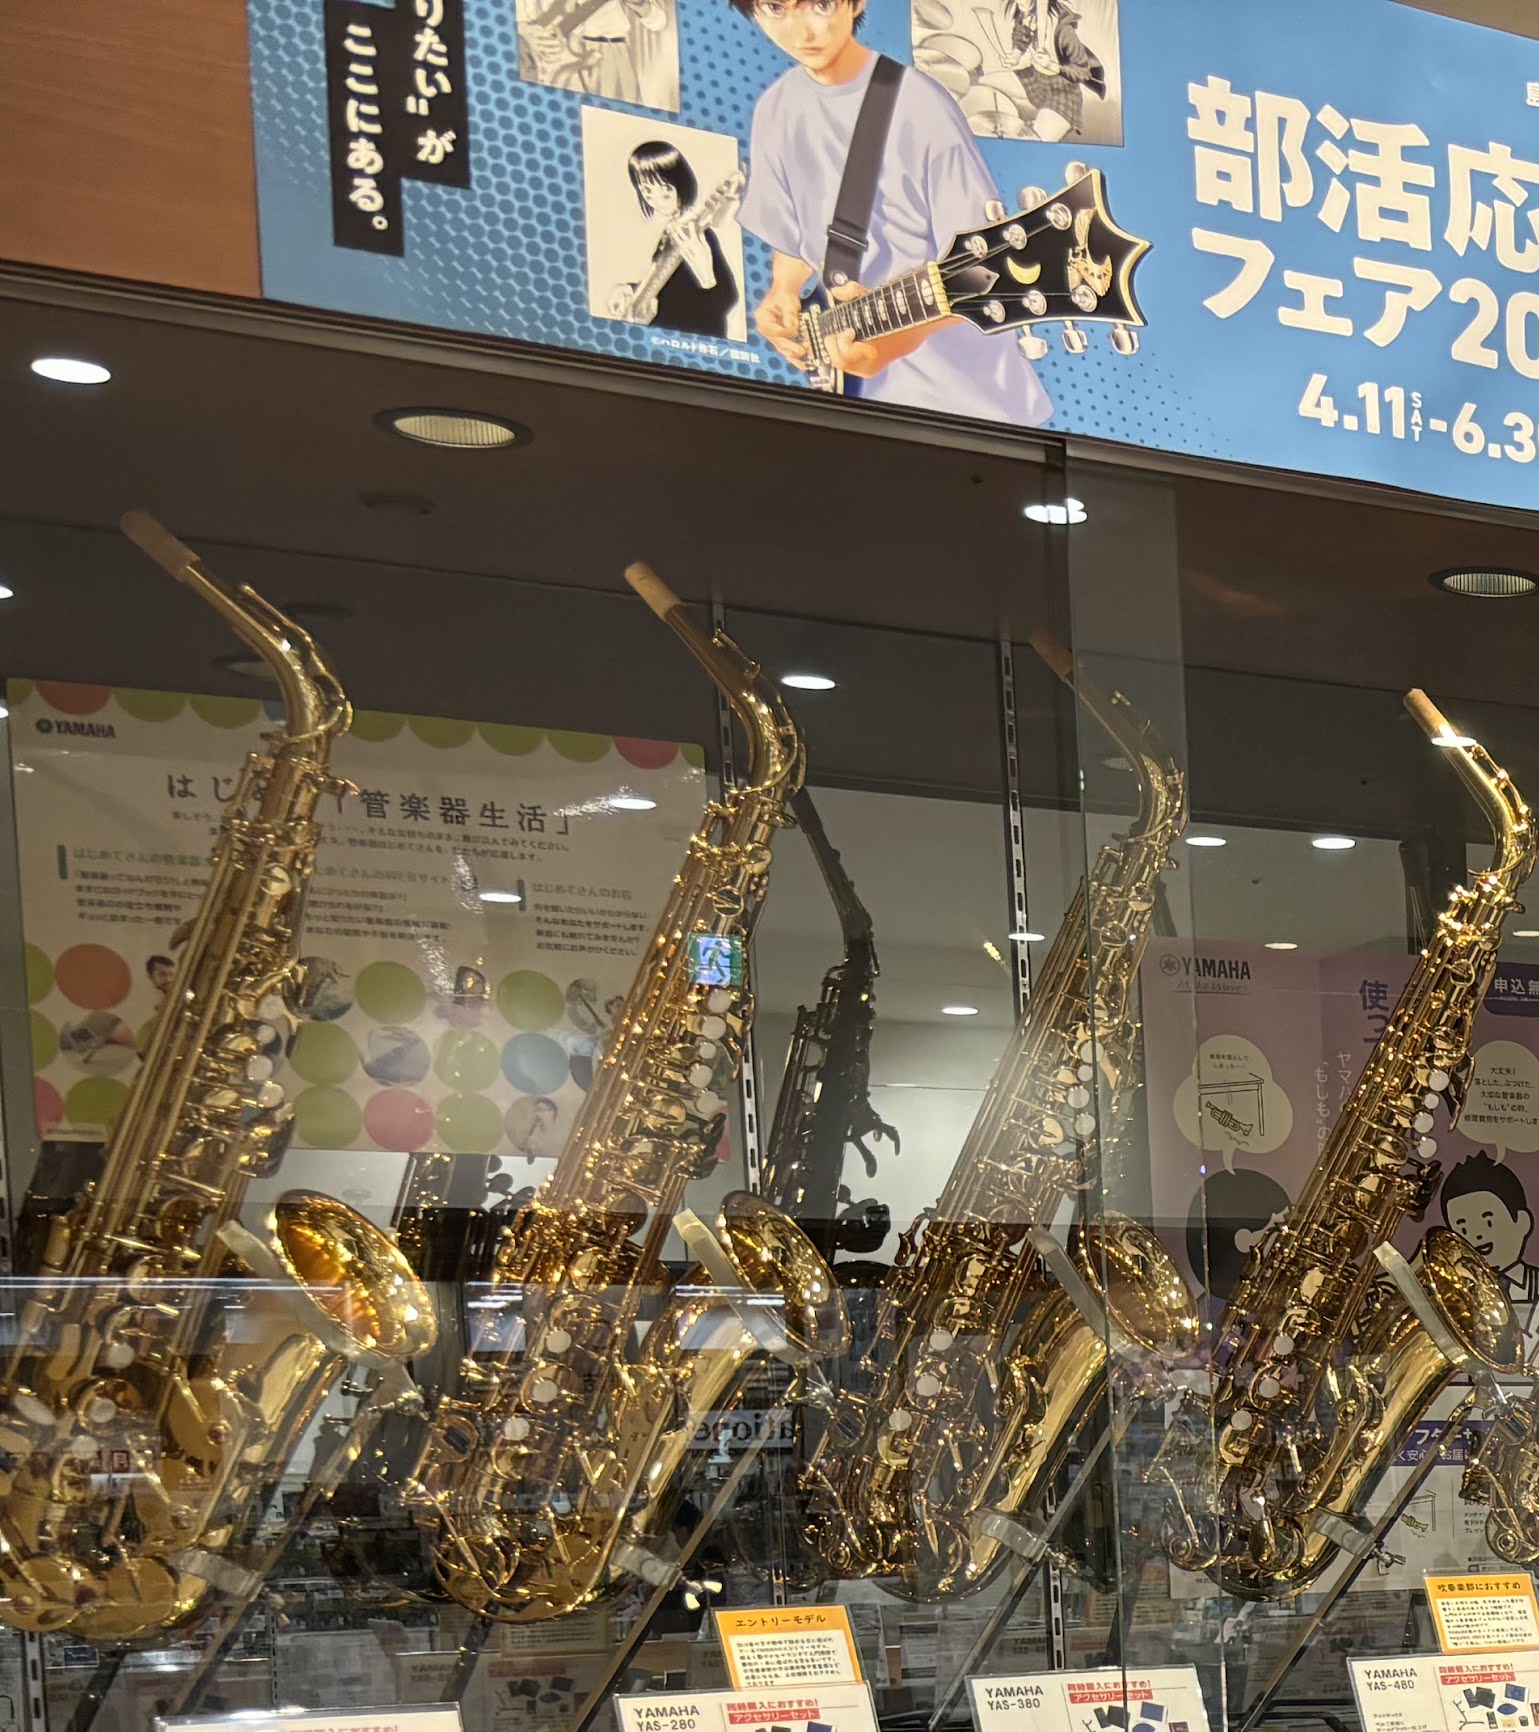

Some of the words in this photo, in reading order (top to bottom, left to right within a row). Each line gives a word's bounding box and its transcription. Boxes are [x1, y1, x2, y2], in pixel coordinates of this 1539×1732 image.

[343, 23, 388, 231] ここにある。
[1298, 373, 1405, 442] 4.11
[1410, 390, 1424, 443] SAT
[55, 720, 117, 740] YAMAHA
[1182, 957, 1251, 980] YAMAHA
[1437, 1582, 1521, 1593] 吹奏楽部におすすめ
[736, 1614, 827, 1629] エントリーモデル
[1364, 1668, 1418, 1680] YAMAHA
[1444, 1672, 1513, 1684] アクセサリーセット
[985, 1685, 1044, 1699] YAMAHA
[1367, 1680, 1415, 1691] YAS-480
[1073, 1690, 1150, 1702] アクセサリーセット
[634, 1704, 700, 1719] YAMAHA
[987, 1698, 1041, 1711] YAS-380
[733, 1709, 816, 1723] アクセサリーセット
[637, 1719, 696, 1732] YAS-280
